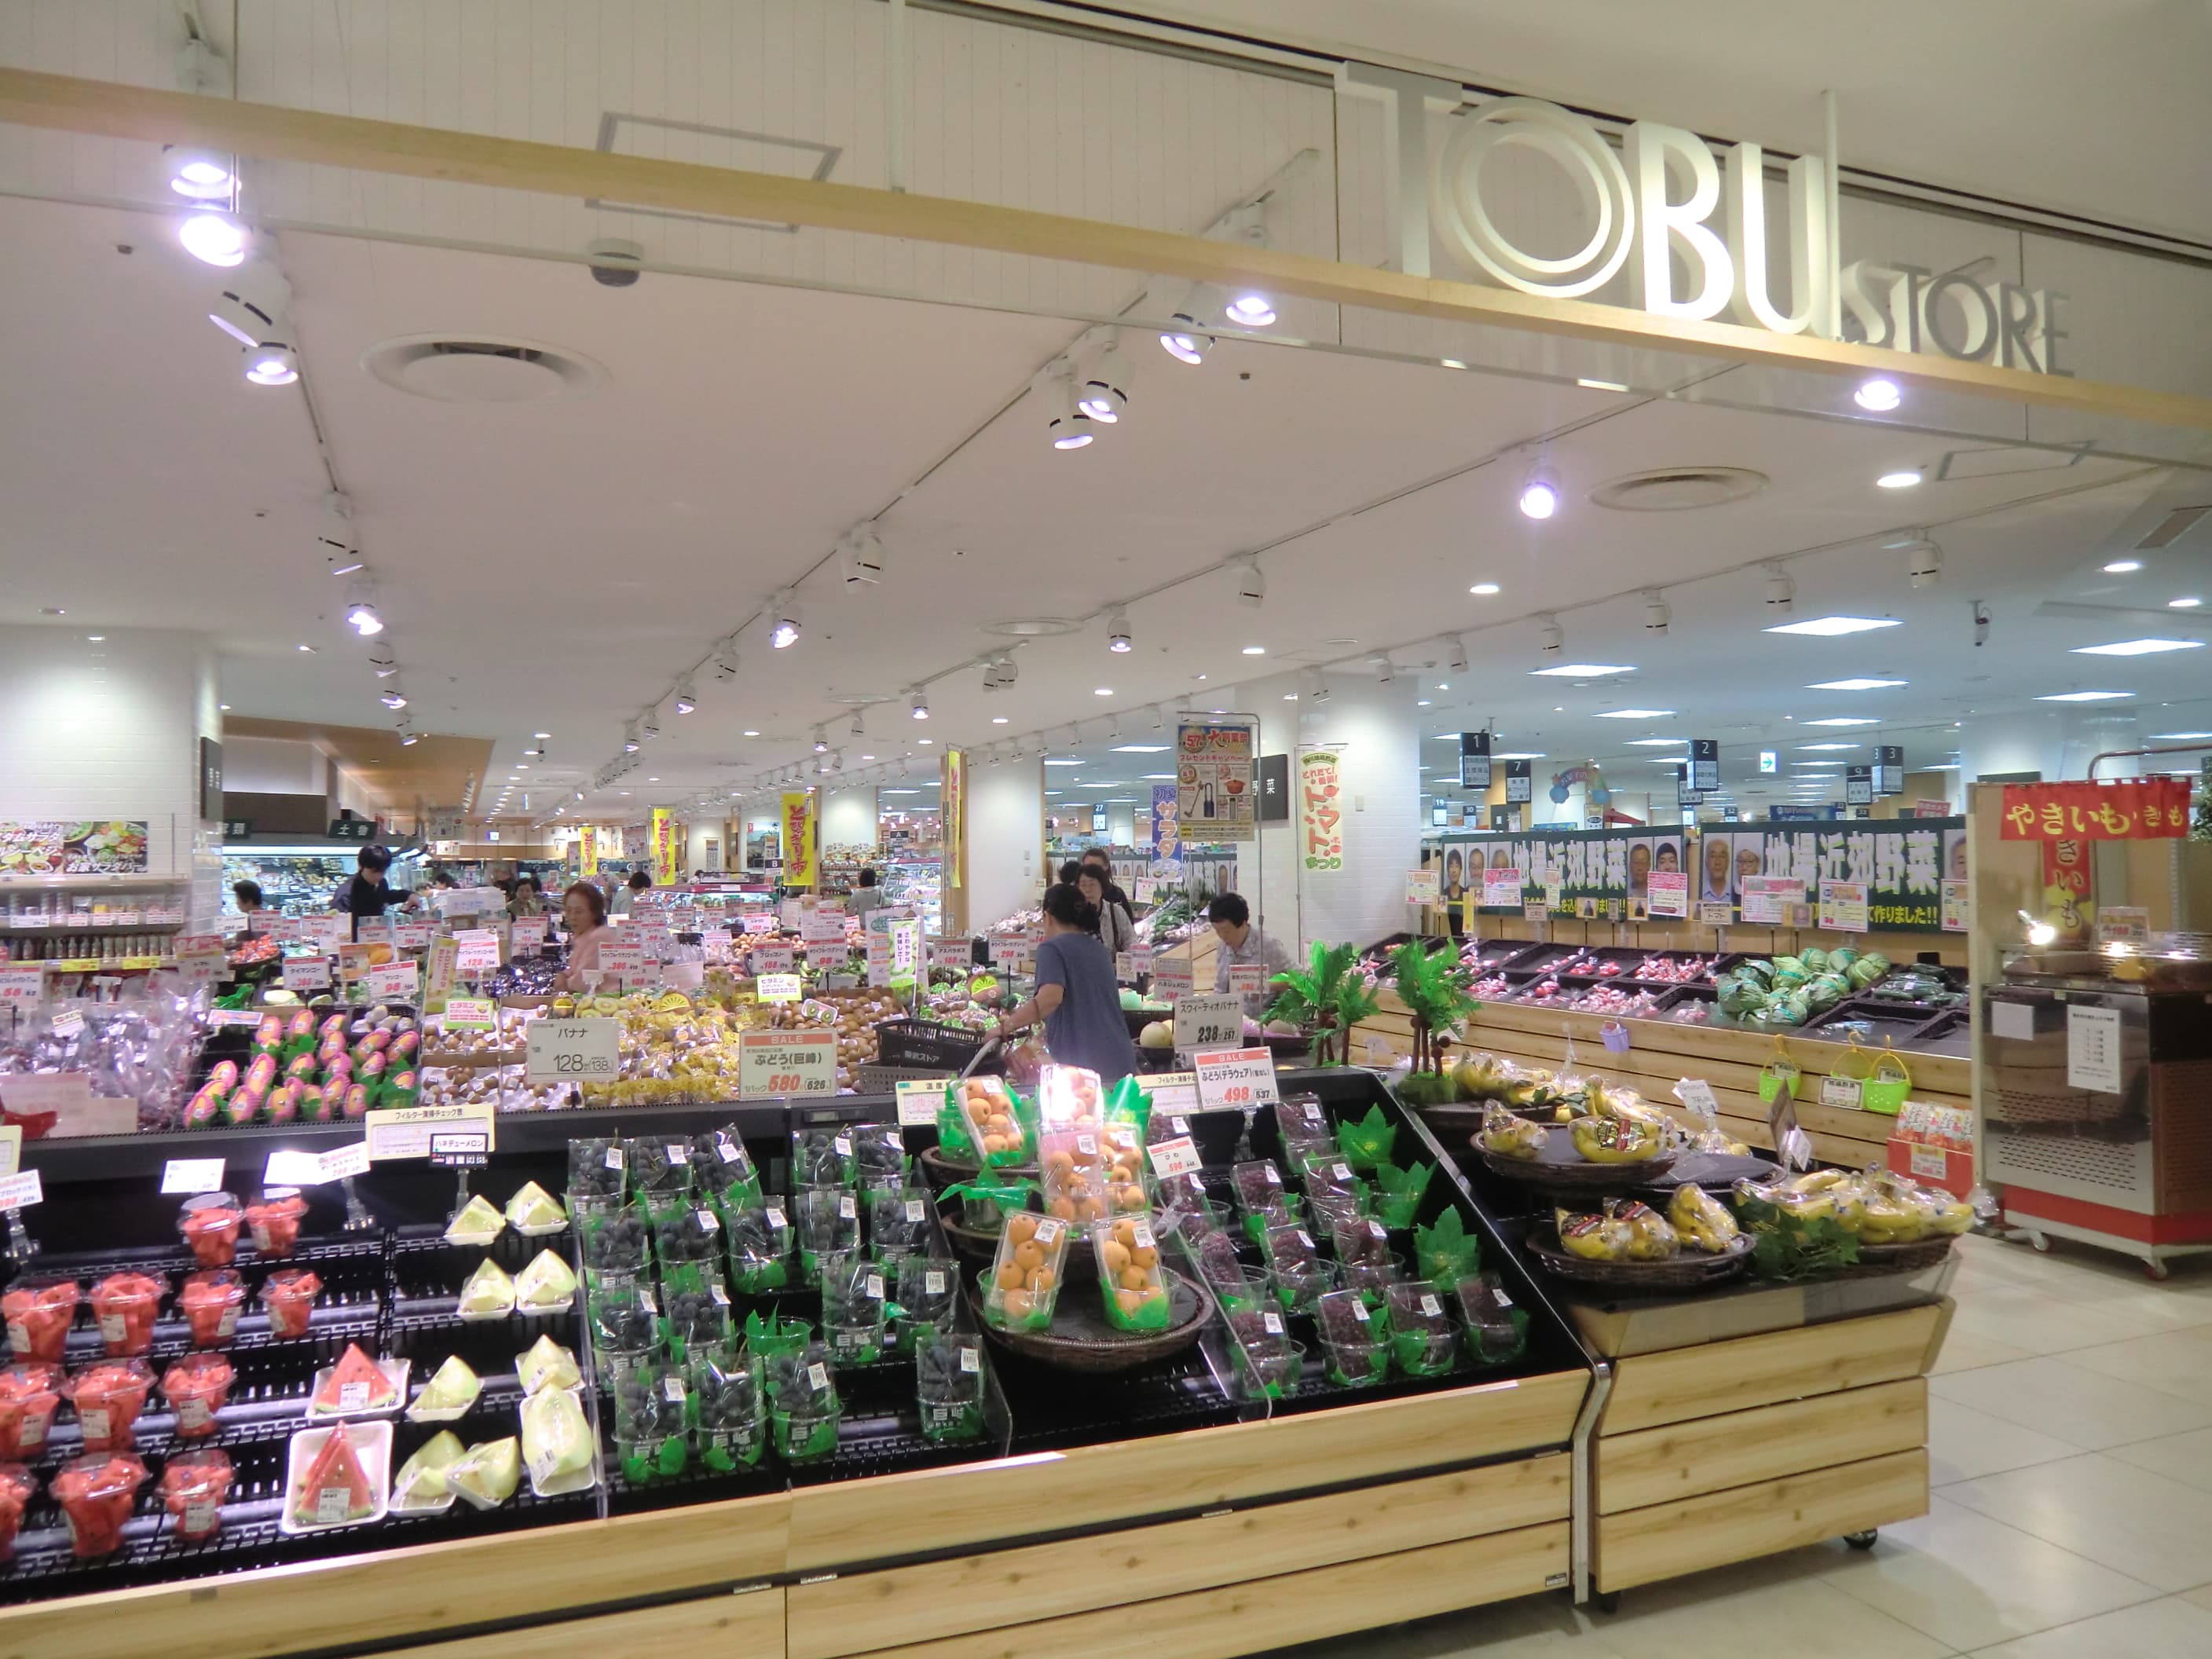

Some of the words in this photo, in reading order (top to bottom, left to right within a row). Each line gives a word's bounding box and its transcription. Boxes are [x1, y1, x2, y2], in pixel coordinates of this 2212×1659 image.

[1334, 61, 1834, 338] TOBU
[1837, 256, 2075, 378] STORE
[1186, 734, 1201, 747] 57
[1473, 734, 1479, 749] 1
[1701, 741, 1710, 754] 2
[1889, 748, 1896, 759] 3
[1514, 760, 1522, 772] 7
[1854, 766, 1862, 776] 9
[2005, 802, 2130, 836] やきいも
[1155, 800, 1178, 859] サラダ
[1305, 856, 1342, 870] まつり
[1180, 1000, 1240, 1014] スウィーティオバナナ
[558, 1027, 588, 1038] バナナ
[1198, 1026, 1218, 1043] 238
[771, 1035, 804, 1045] SALE
[554, 1053, 584, 1072] 128
[754, 1052, 822, 1066] ぶどう(巨峰)
[1218, 1053, 1245, 1062] SALE
[767, 1074, 801, 1092] 580
[1224, 1086, 1251, 1103] 498
[434, 1140, 484, 1148] ハネデューメロン
